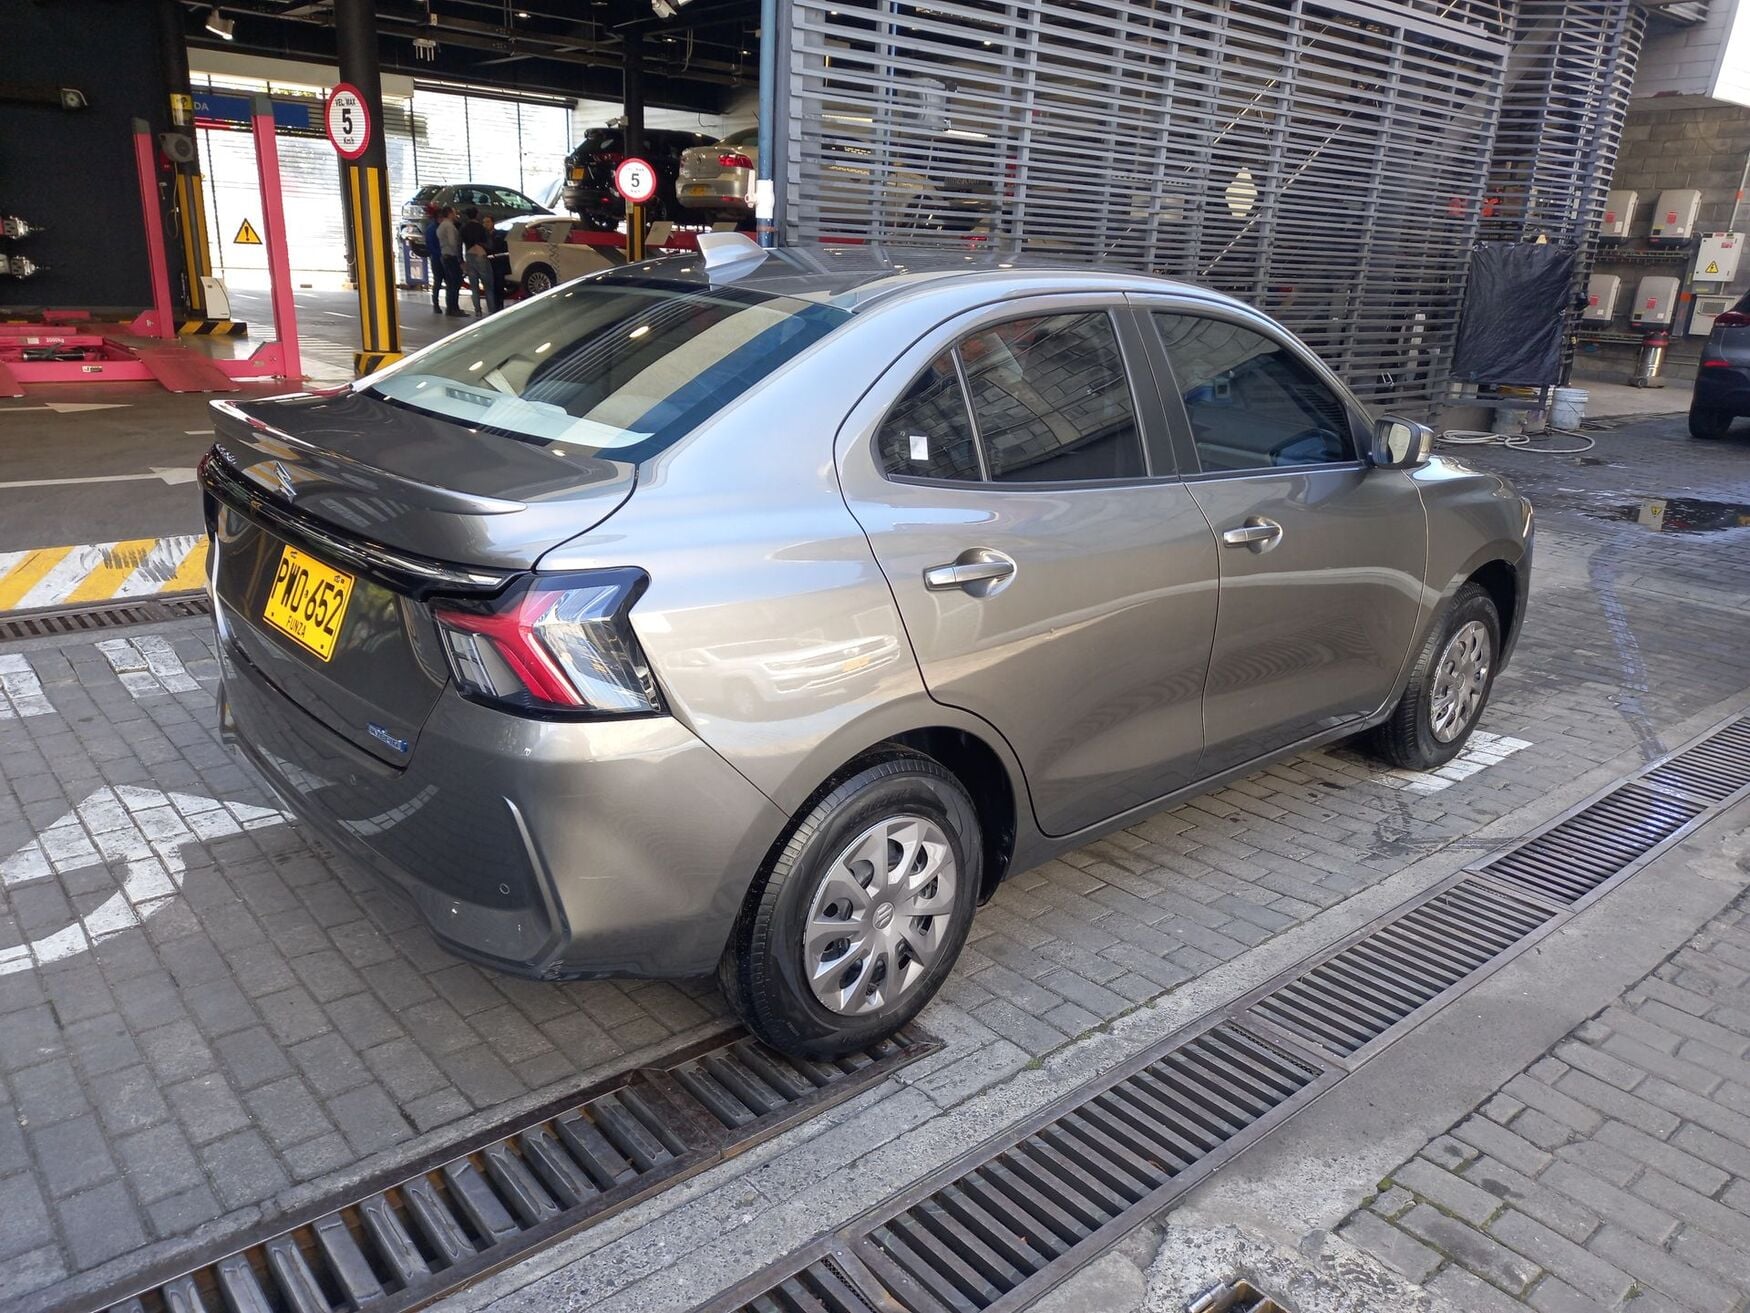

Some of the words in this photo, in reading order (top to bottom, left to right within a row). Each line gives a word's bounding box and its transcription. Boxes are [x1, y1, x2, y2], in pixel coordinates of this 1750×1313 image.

[342, 108, 353, 135] 5
[631, 173, 640, 188] 5
[286, 615, 307, 638] FUNZA
